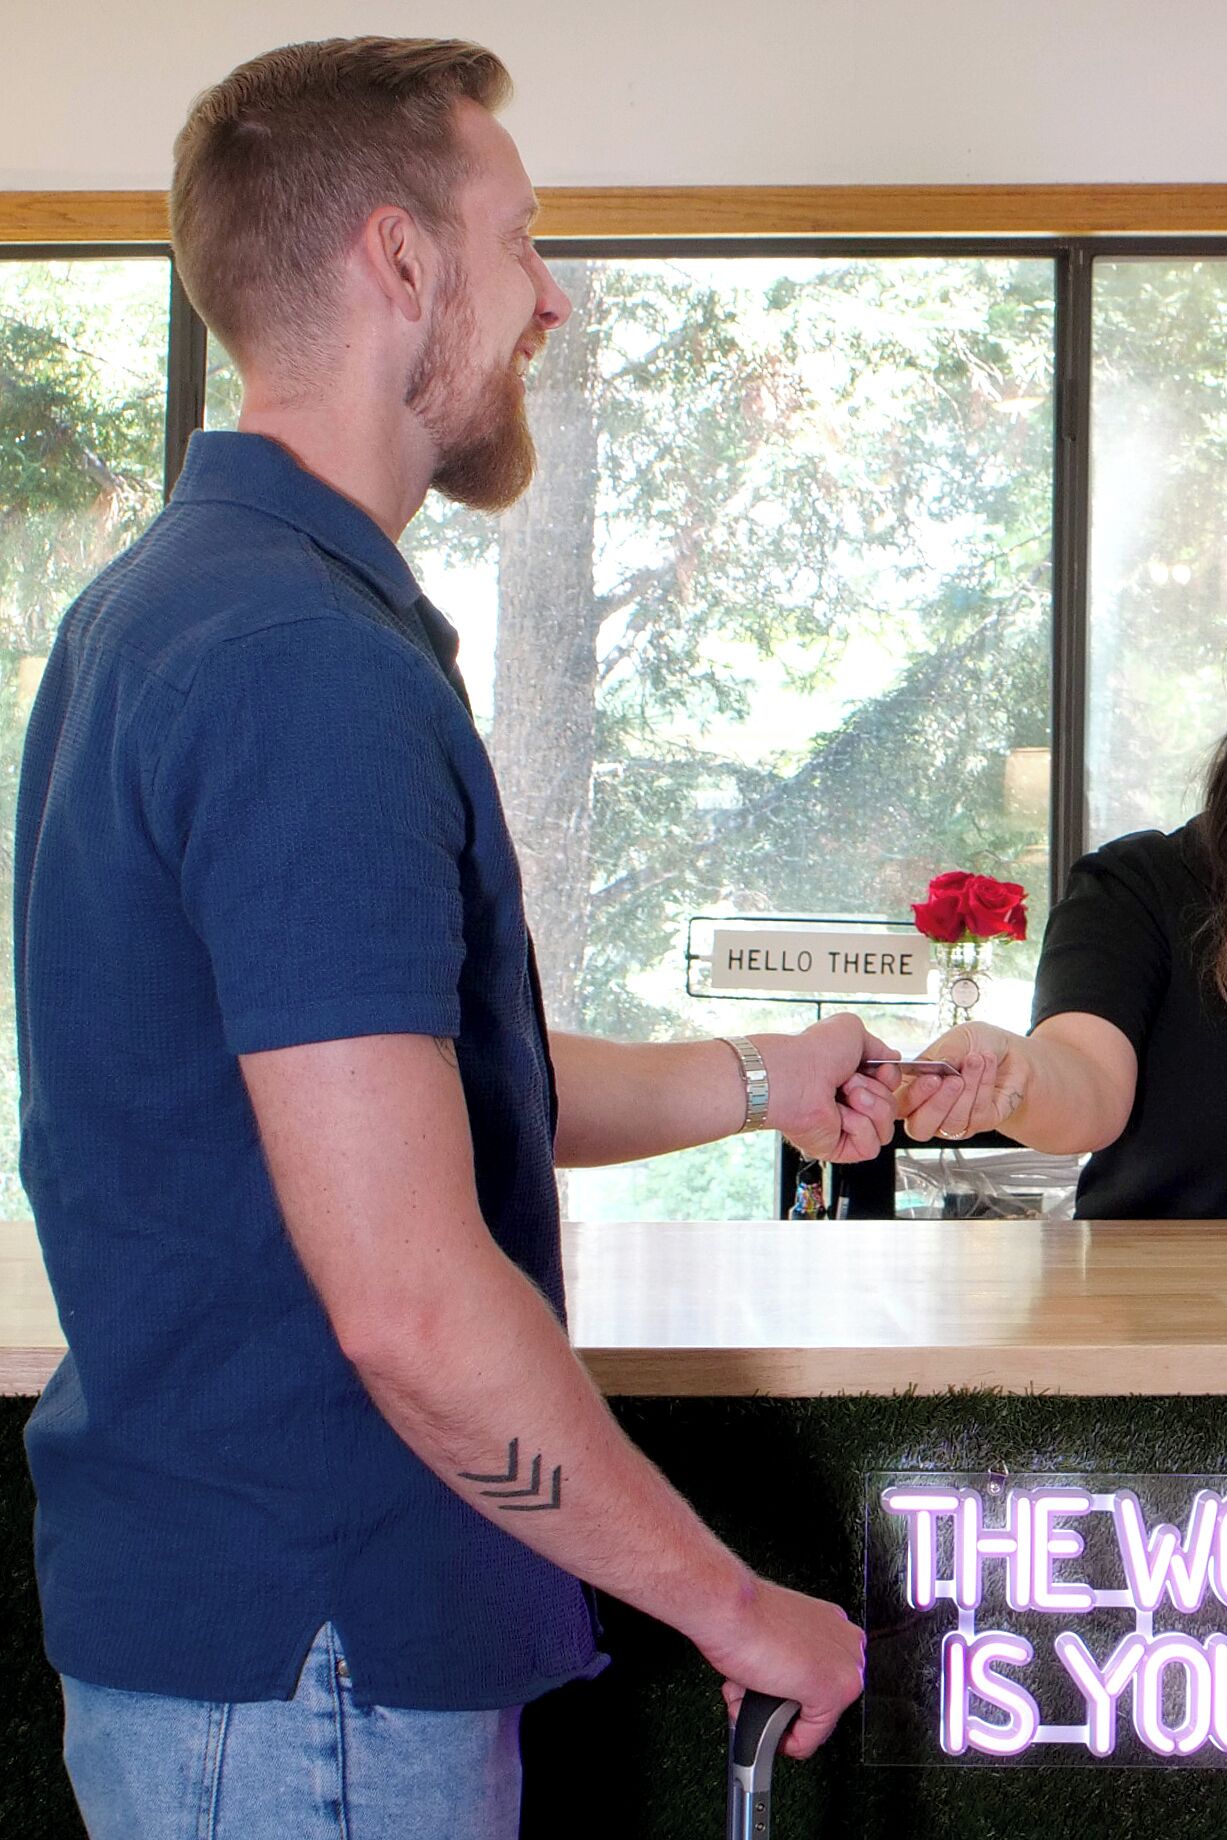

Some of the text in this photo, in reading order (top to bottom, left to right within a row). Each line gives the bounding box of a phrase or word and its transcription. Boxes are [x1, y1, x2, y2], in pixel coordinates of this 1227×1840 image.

[728, 949, 914, 976] HELLO THERE
[882, 1487, 1096, 1612] THE
[941, 1632, 1039, 1758] IS
